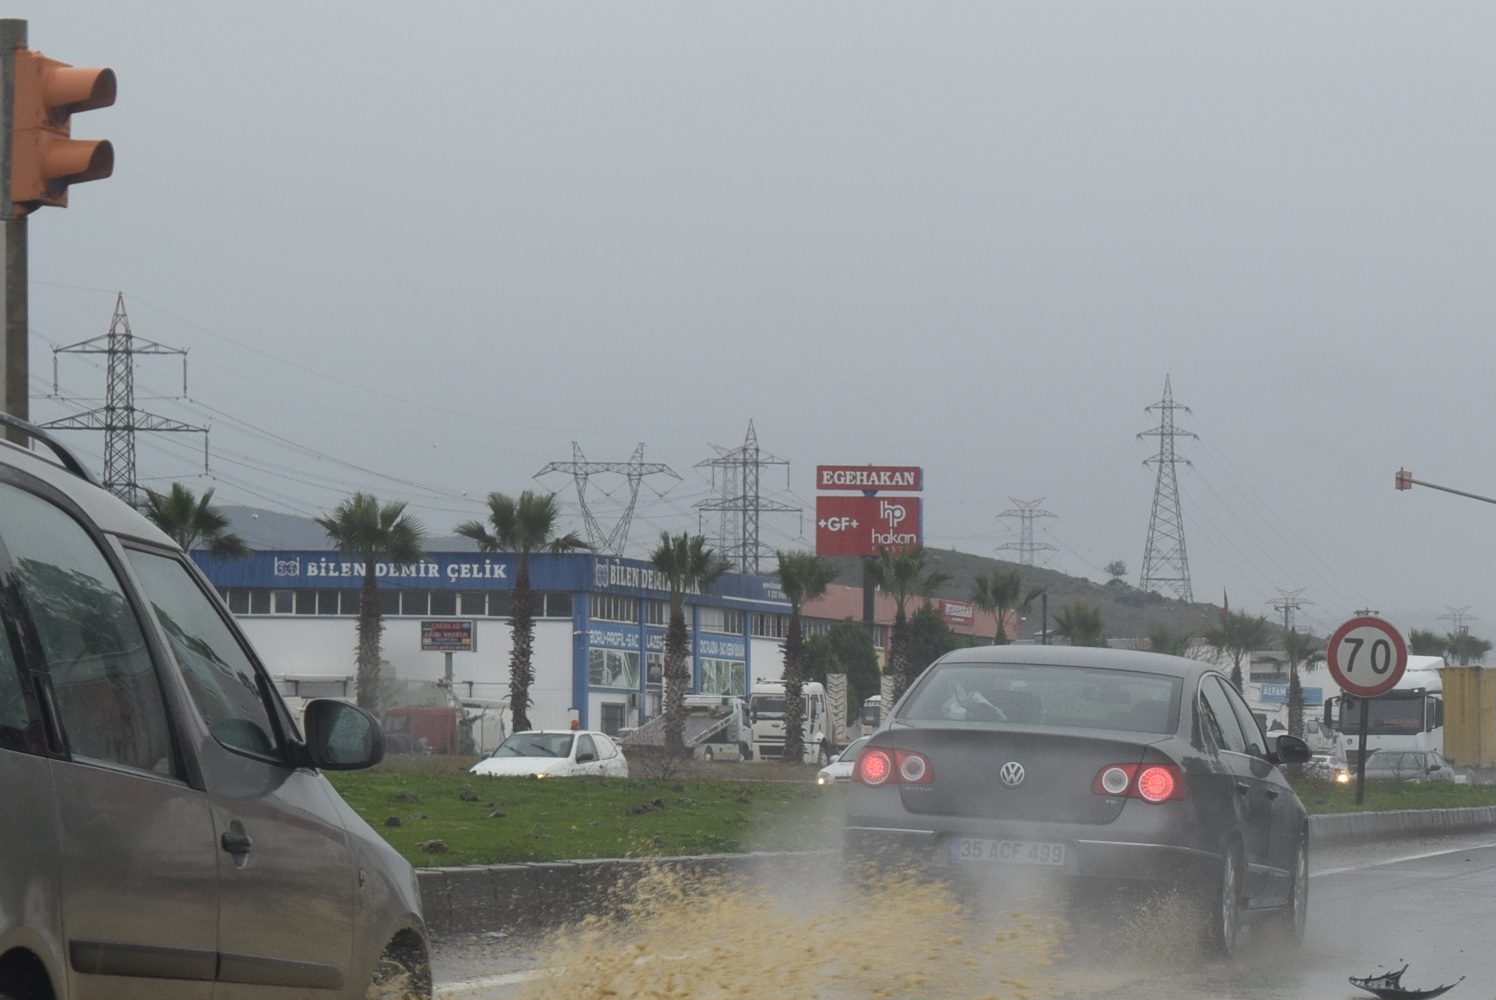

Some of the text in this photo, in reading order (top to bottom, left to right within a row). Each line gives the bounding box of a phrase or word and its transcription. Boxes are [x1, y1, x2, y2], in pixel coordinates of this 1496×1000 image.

[822, 470, 915, 486] EGEHAKAN
[871, 528, 917, 544] hakan
[306, 557, 367, 578] BİLEN
[446, 559, 507, 583] ÇELİK
[610, 559, 639, 589] BİLEN
[1344, 637, 1391, 675] 70
[960, 840, 984, 859] 35
